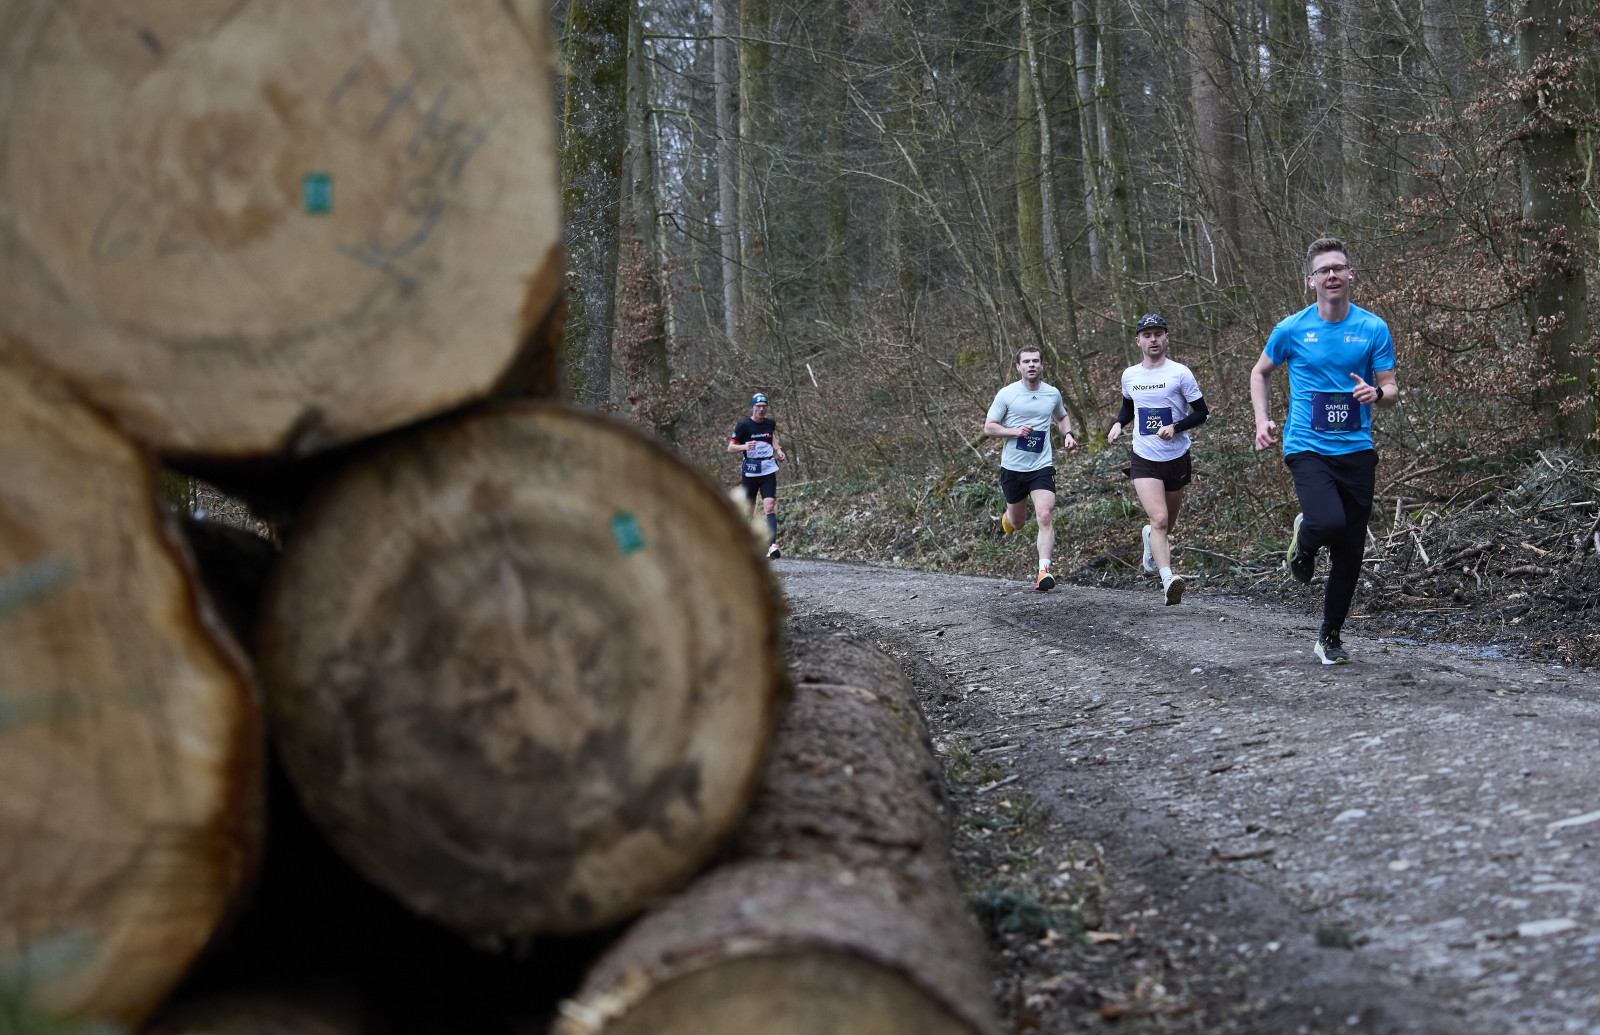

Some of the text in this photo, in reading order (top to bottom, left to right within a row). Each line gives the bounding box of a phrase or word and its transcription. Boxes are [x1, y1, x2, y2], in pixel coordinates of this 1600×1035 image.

[1327, 411, 1348, 423] 819
[1146, 420, 1164, 429] 224
[1026, 440, 1037, 448] 29
